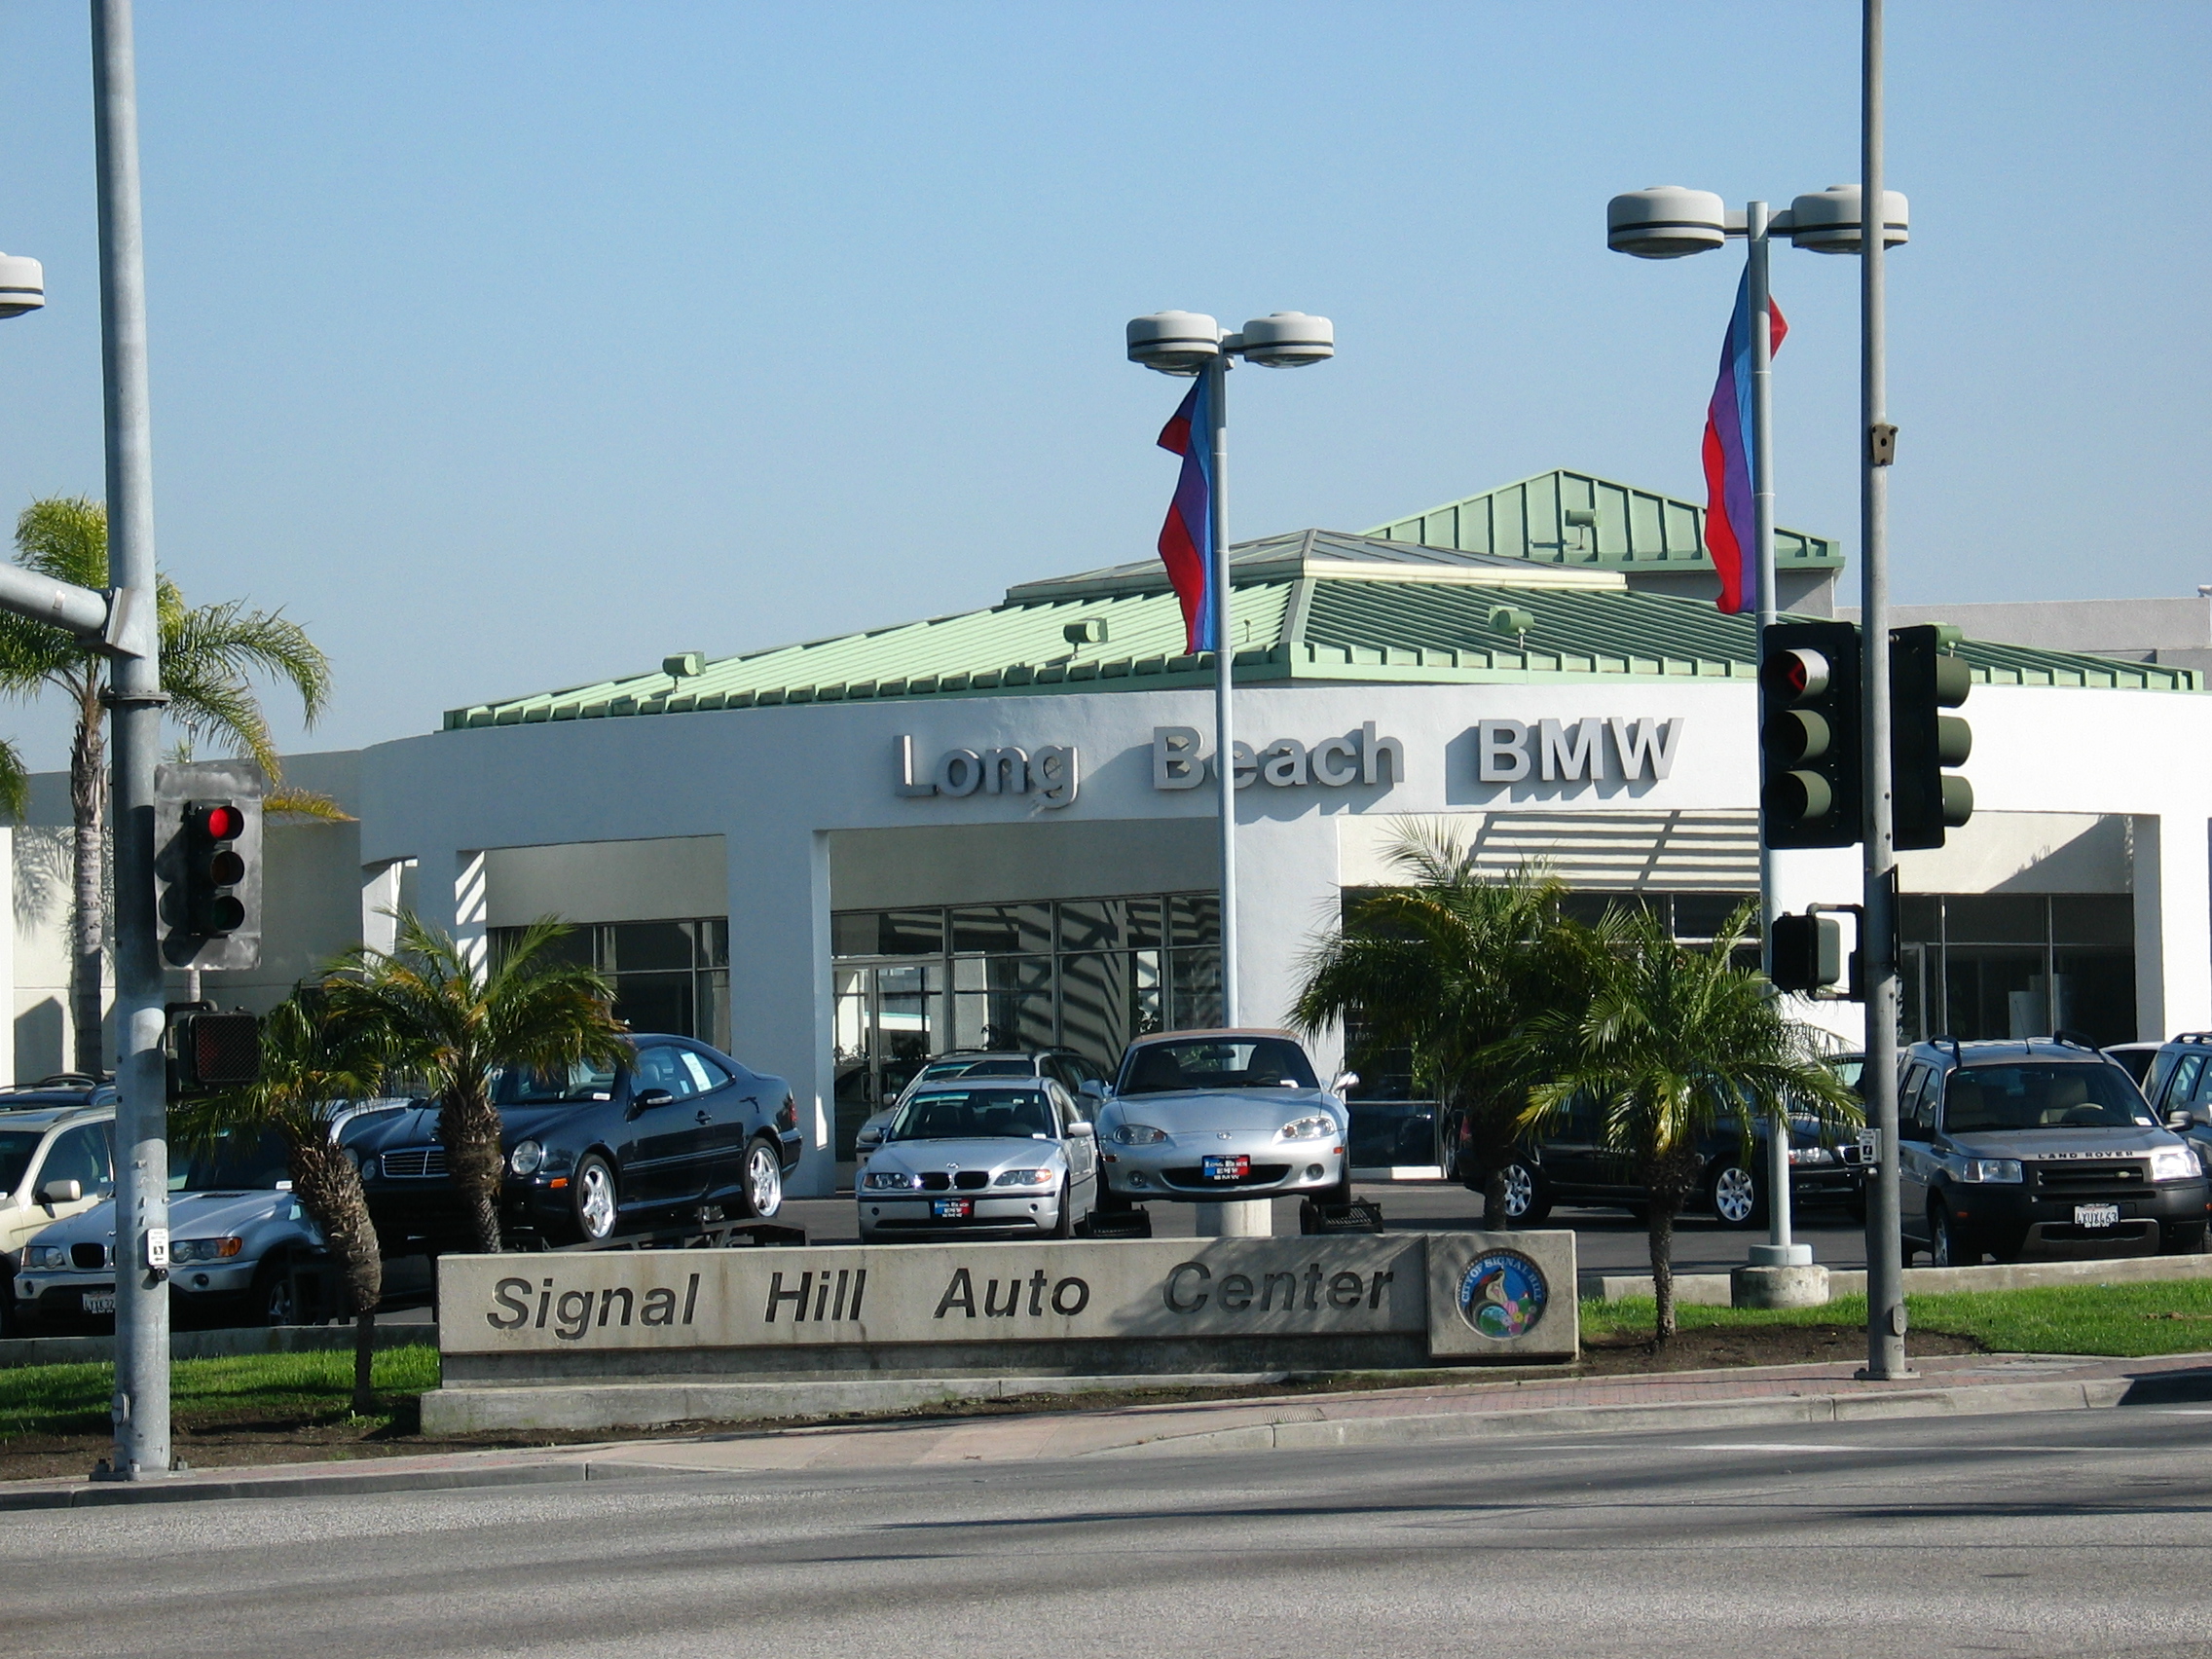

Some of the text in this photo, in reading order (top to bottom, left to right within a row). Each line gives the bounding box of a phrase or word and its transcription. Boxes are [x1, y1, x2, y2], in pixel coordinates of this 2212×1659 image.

[893, 717, 1685, 809] Long Beach BMW
[486, 1261, 1394, 1341] Signal Hill Auto Center
[1461, 1256, 1543, 1303] CITY OF SIGNAL HILL
